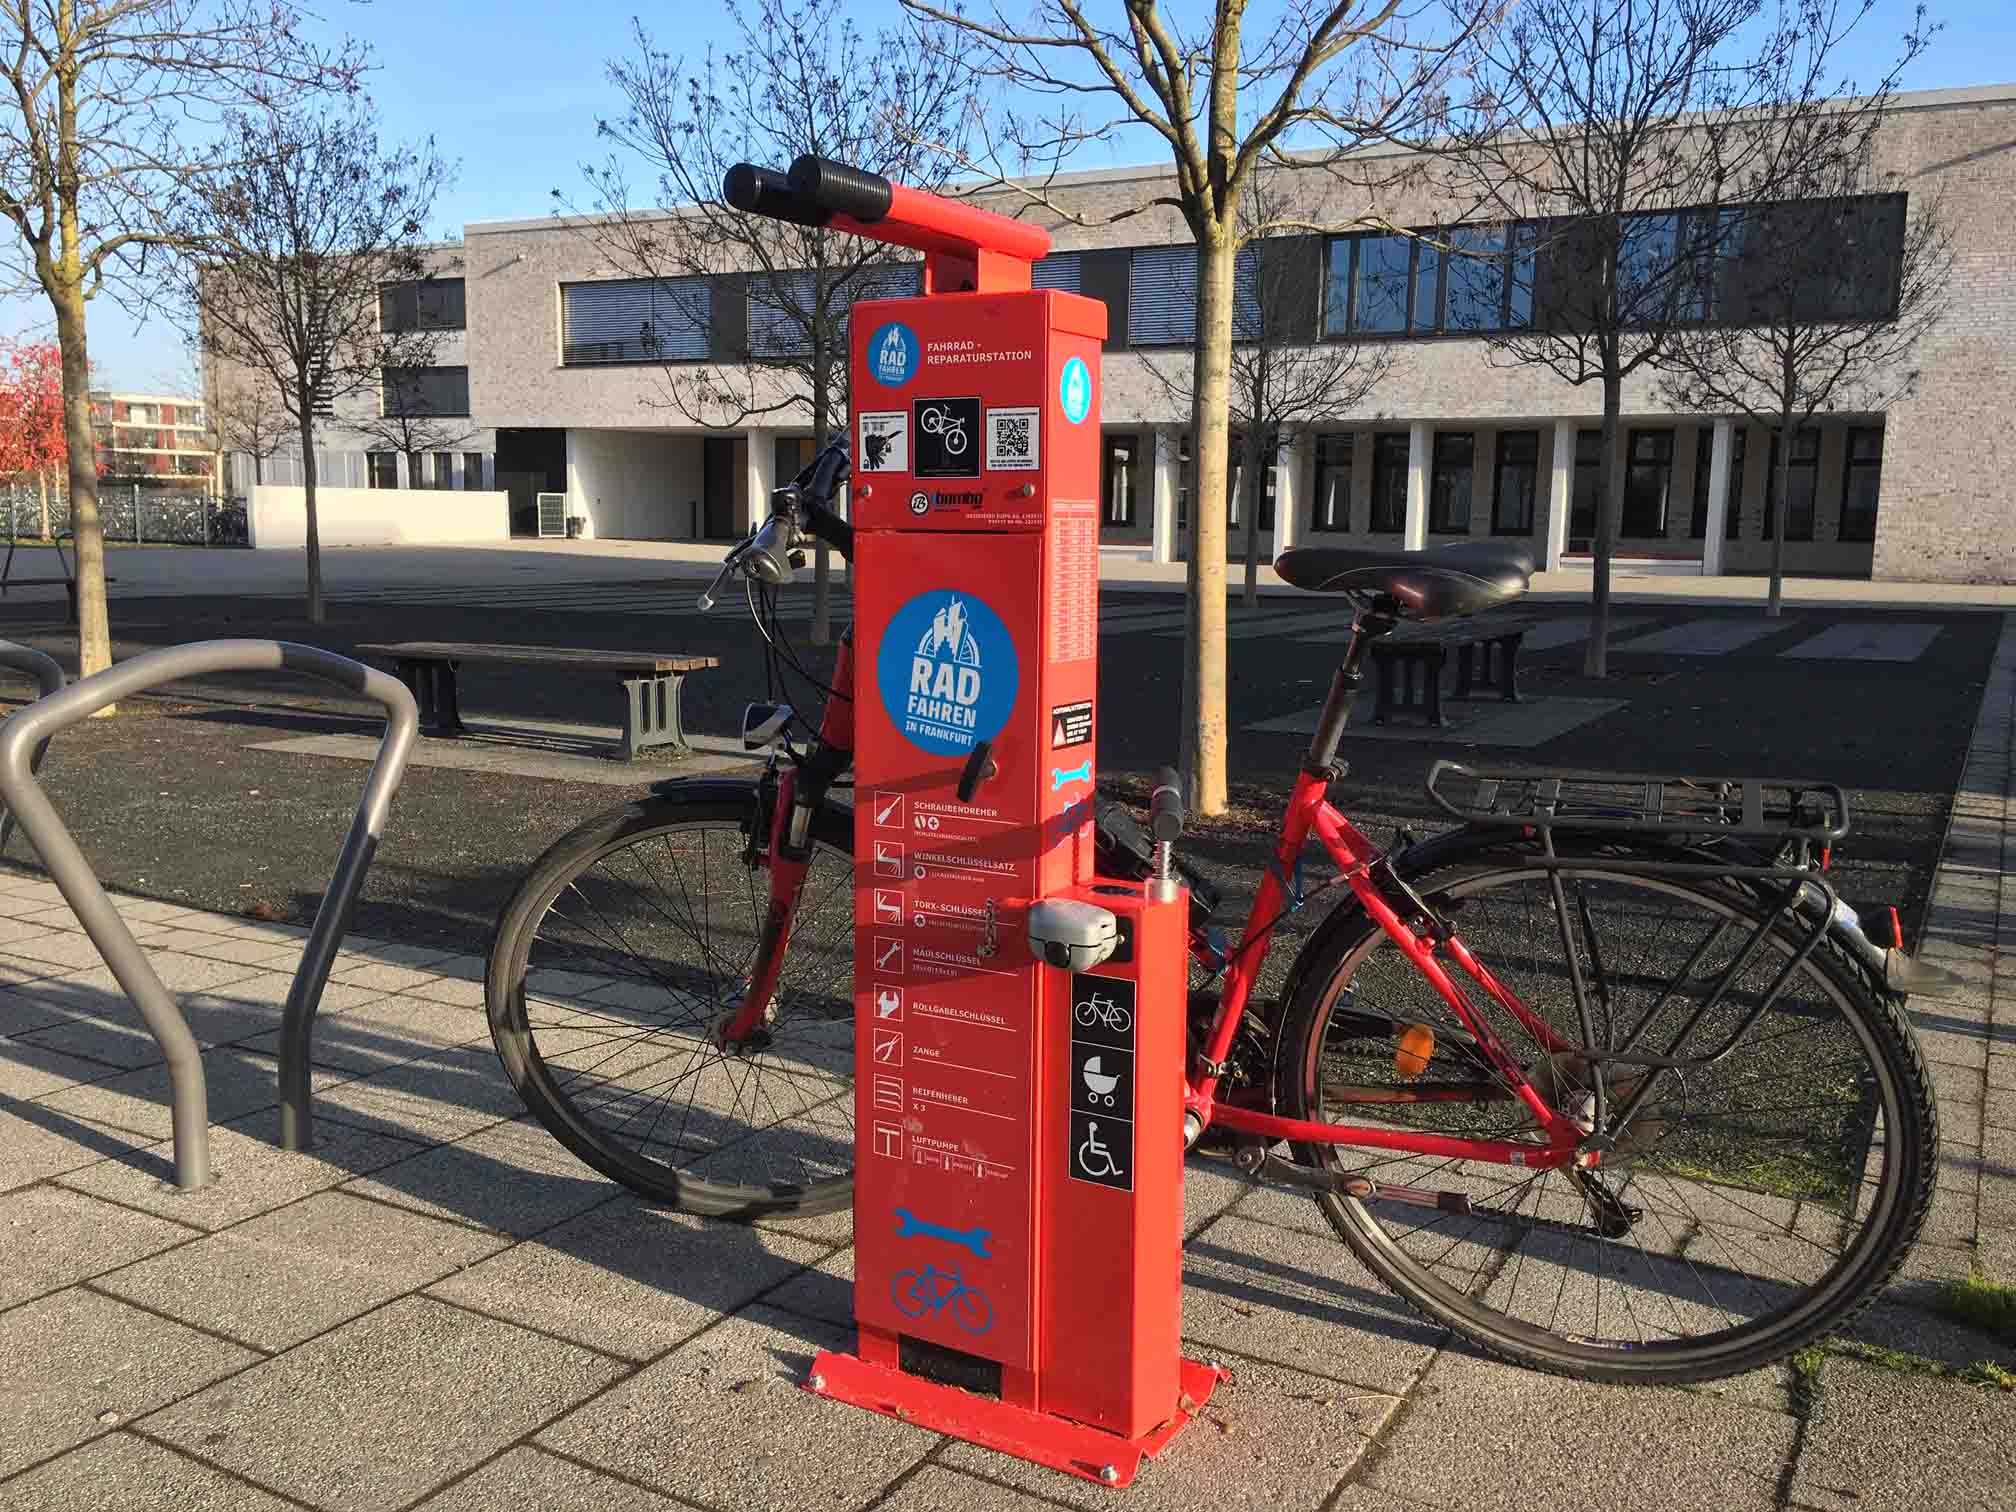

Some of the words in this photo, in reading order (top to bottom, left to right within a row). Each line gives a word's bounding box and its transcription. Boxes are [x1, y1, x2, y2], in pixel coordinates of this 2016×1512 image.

[928, 341, 975, 352] FAHRRAD
[880, 349, 906, 366] RAD
[928, 350, 1032, 365] REPARATURSTATION
[910, 656, 981, 705] RAD
[907, 695, 977, 728] FAHREN
[905, 720, 917, 732] IN
[919, 723, 973, 746] FRANKFURT
[914, 801, 998, 817] SCHRAUBENDREHER
[913, 1045, 940, 1057] ZANGE
[912, 1087, 968, 1104] REIFENHEBER
[912, 1135, 959, 1152] LUFTPUMPE
